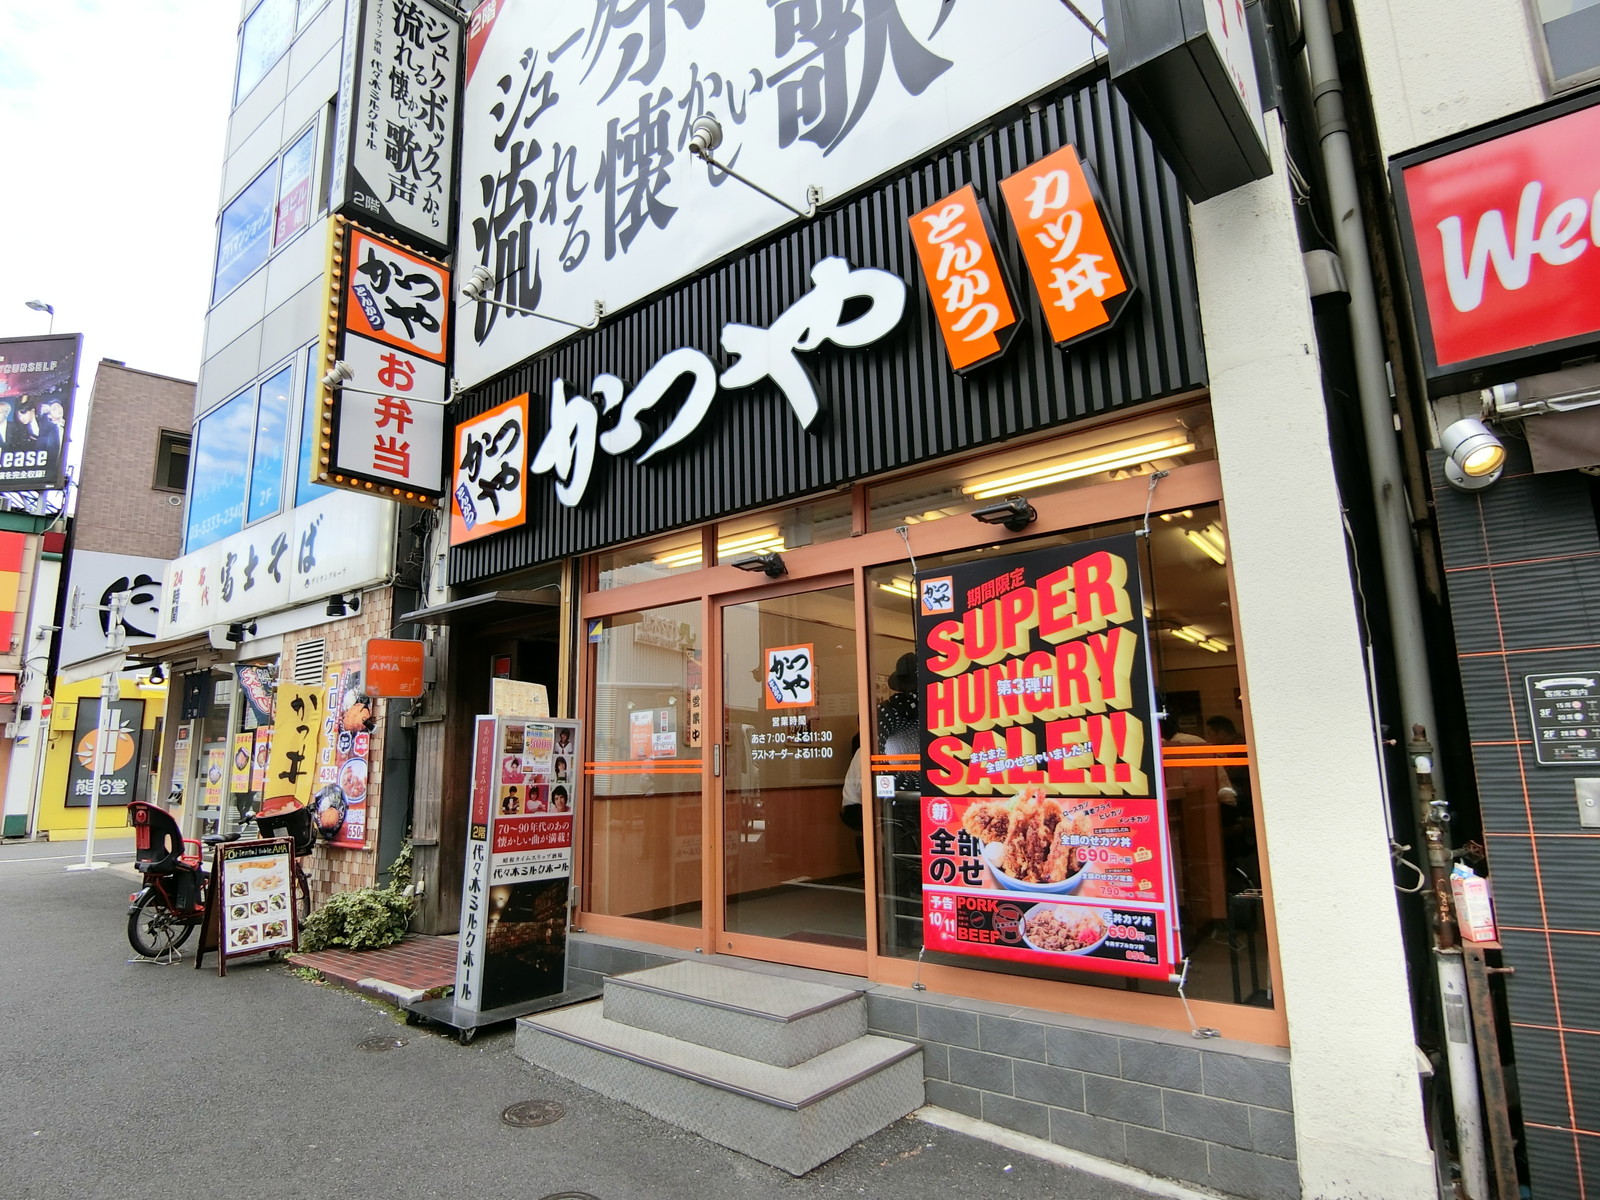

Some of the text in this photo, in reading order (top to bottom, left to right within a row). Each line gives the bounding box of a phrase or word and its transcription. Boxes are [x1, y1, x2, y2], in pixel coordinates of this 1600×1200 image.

[469, 0, 497, 40] 2階
[365, 58, 383, 151] 代々木ミルクホール
[414, 16, 451, 229] ジュークボックスから
[353, 191, 381, 214] 2階
[1023, 169, 1112, 312] カツ丼
[1437, 181, 1600, 312] We
[922, 204, 1000, 342] とんかつ
[358, 247, 440, 340] かつや
[531, 255, 907, 508] かつや
[371, 352, 416, 478] お弁当
[457, 419, 521, 515] かつや
[259, 488, 272, 508] 2F
[220, 513, 324, 603] 富士そば
[924, 583, 951, 608] かつや
[967, 567, 1026, 608] 期間限定
[926, 551, 1126, 675] SUPER
[369, 654, 399, 662] oriental
[370, 662, 400, 672] AMA
[769, 654, 810, 700] かつや
[927, 627, 1130, 733] HUNGRY
[996, 676, 1053, 696] 第3弾!!
[322, 673, 339, 764] コロッケそば
[771, 715, 807, 728] 営業時間
[1539, 708, 1551, 717] 3F
[1543, 730, 1555, 738] 2F
[927, 712, 1142, 792] SALE!!
[969, 747, 1007, 762] またまた
[931, 803, 948, 821] 新
[1062, 801, 1089, 817] ロースカツ
[1118, 816, 1149, 824] メンチカツ
[473, 826, 487, 840] 2階
[929, 828, 983, 857] 全部
[1061, 834, 1132, 848] 全部のせカツ丼
[272, 844, 288, 854] AMA
[493, 862, 570, 880] 代々木ミルクホール
[929, 858, 985, 887] のせ
[930, 895, 953, 911] 予告
[957, 896, 999, 913] PORK
[460, 843, 485, 1001] 代々木ミルクホール
[929, 912, 955, 933] 10/11
[957, 927, 1000, 944] BEEF
